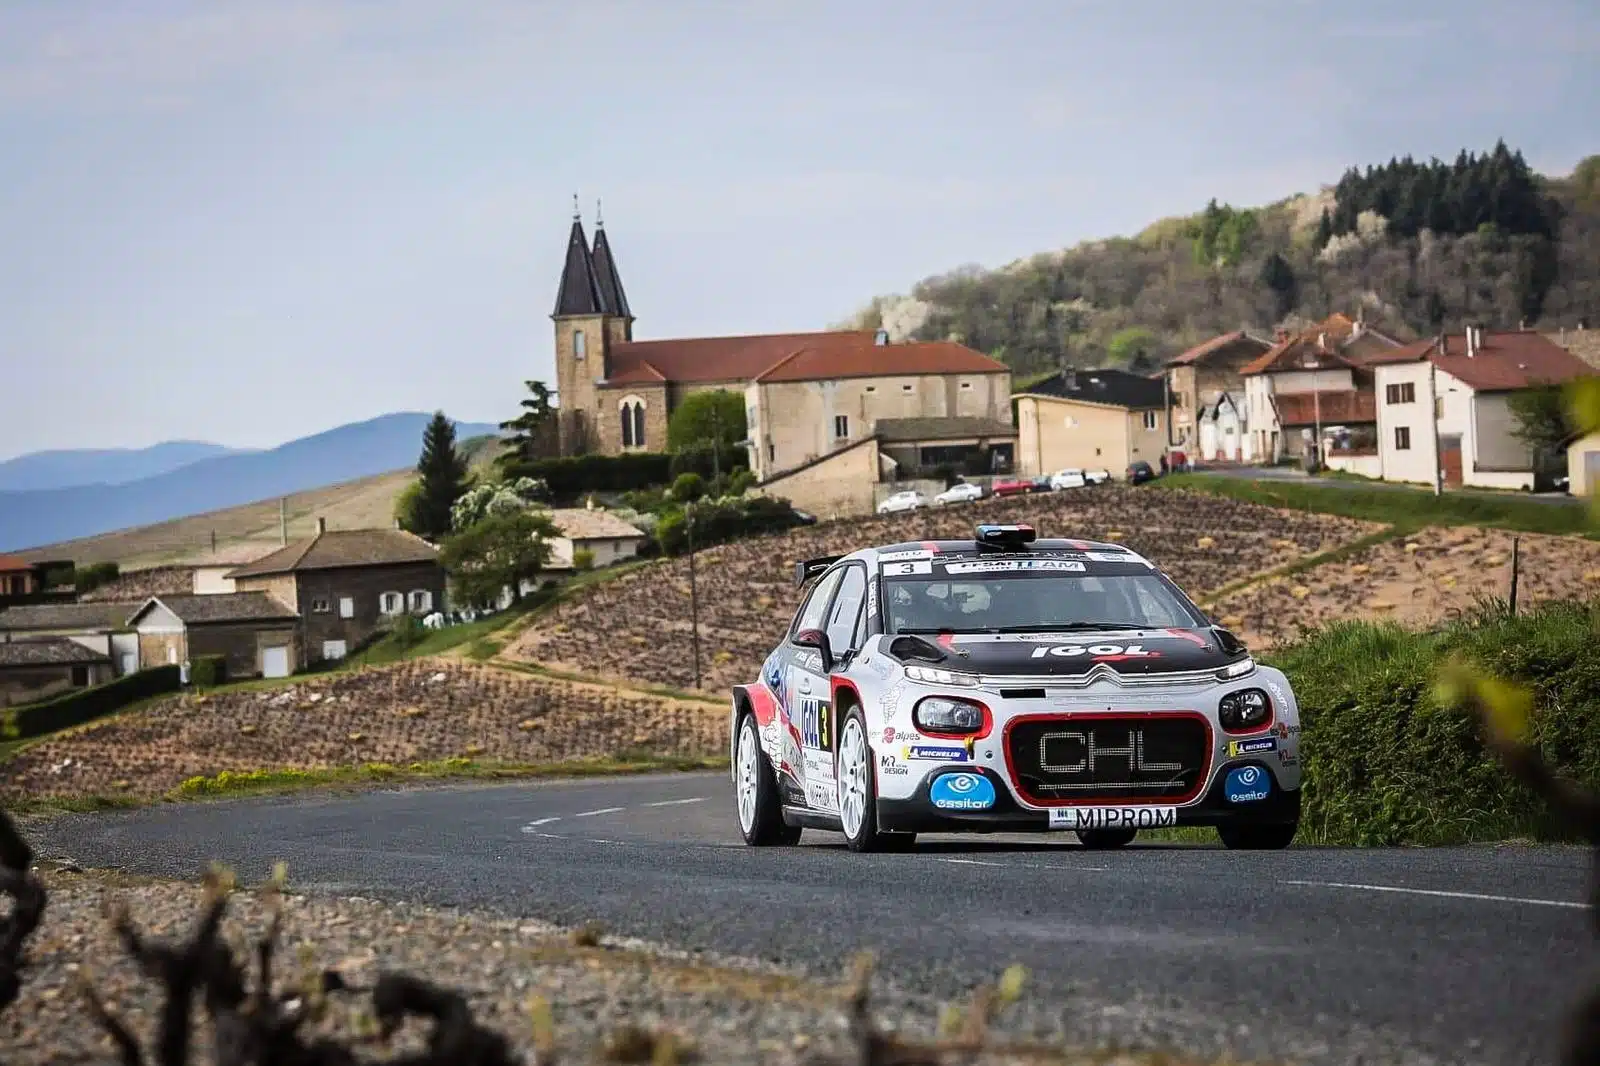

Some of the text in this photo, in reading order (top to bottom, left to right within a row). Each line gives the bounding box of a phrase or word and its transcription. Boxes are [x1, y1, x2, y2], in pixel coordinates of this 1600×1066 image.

[900, 563, 915, 574] 3
[1030, 645, 1150, 658] IGOL
[801, 699, 829, 748] IGOL 3
[895, 731, 921, 742] alpes
[1039, 730, 1182, 772] CHL
[1245, 742, 1273, 751] MICHELIN
[919, 749, 961, 758] MICHELIN
[1230, 789, 1268, 803] essilor
[935, 798, 990, 809] essilor
[1076, 808, 1174, 828] MIPROM
